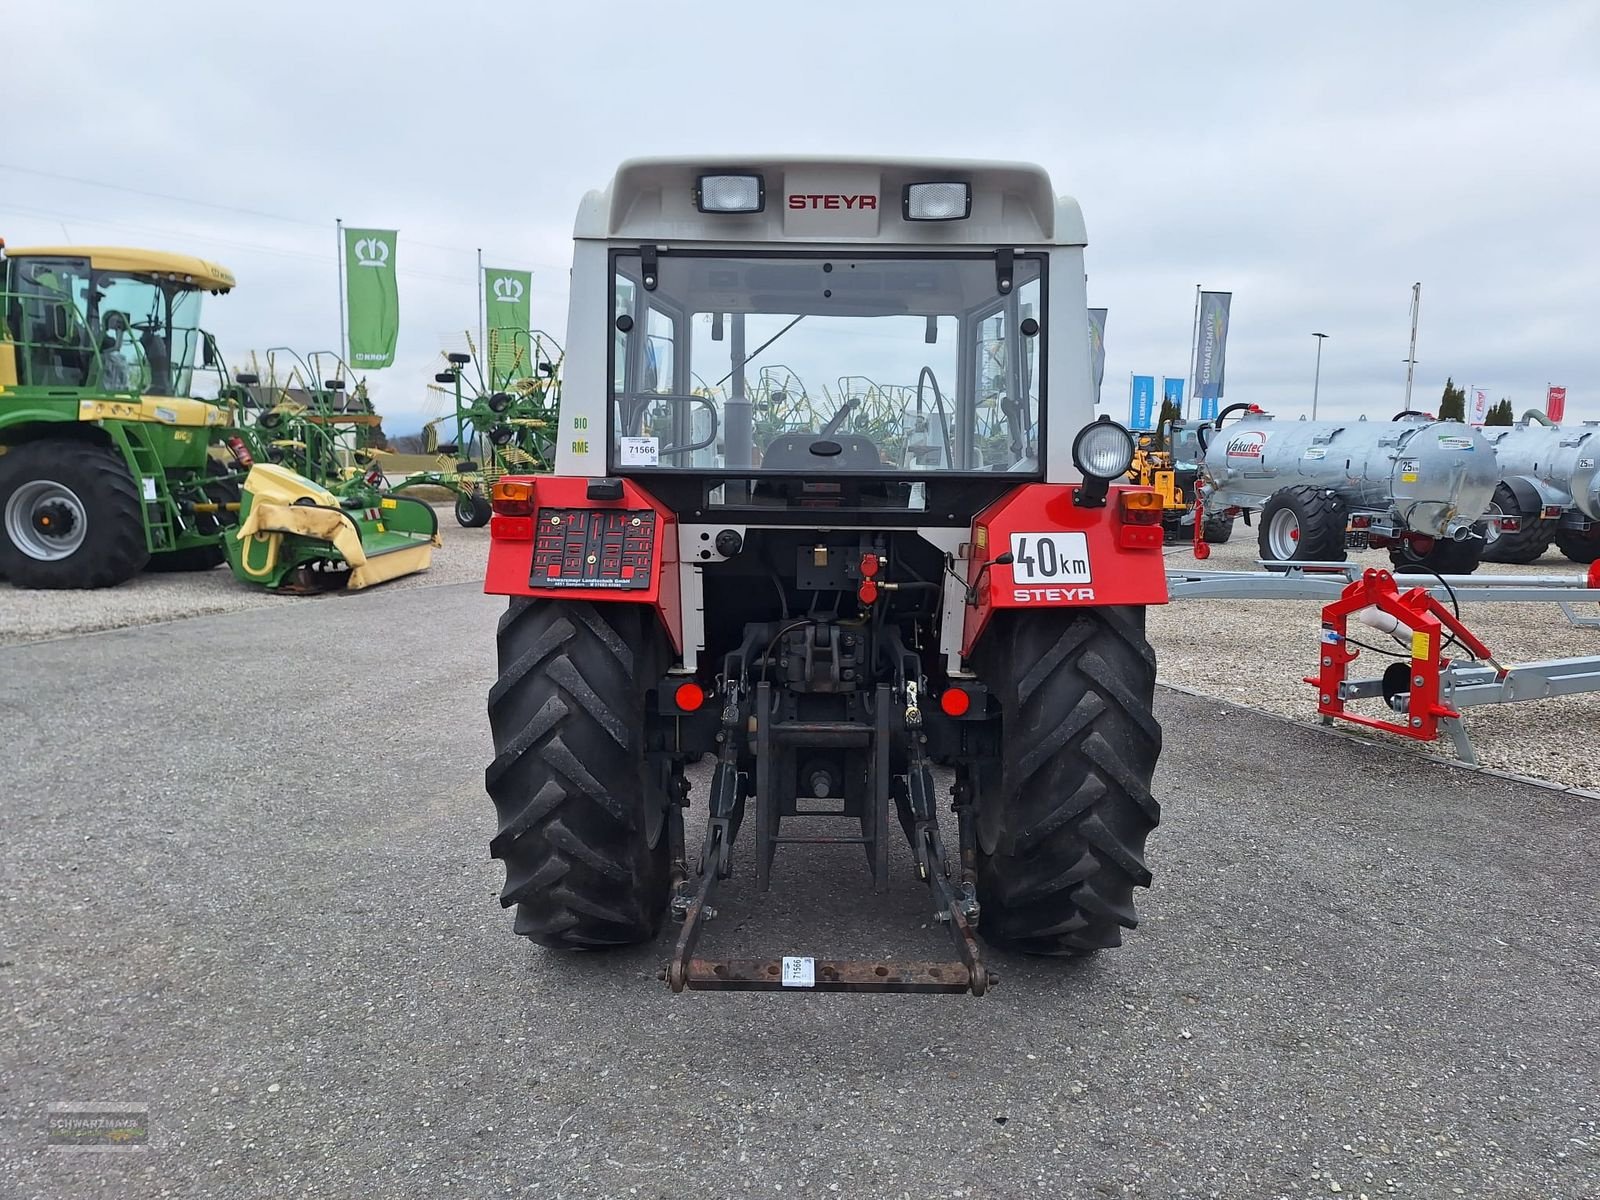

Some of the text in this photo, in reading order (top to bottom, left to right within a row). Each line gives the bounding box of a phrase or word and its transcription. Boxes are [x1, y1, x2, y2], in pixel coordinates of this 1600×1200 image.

[788, 194, 877, 210] STEYR
[1202, 313, 1215, 385] SCHWARZMAYR
[574, 417, 588, 429] BIO
[571, 441, 589, 453] RME
[629, 446, 656, 454] 71566
[1226, 438, 1264, 455] Vakutec
[1402, 461, 1413, 472] 25
[1580, 459, 1588, 467] 25
[1017, 538, 1057, 577] 40
[1060, 554, 1086, 574] km
[1014, 588, 1095, 601] STEYR
[792, 959, 802, 979] 71566
